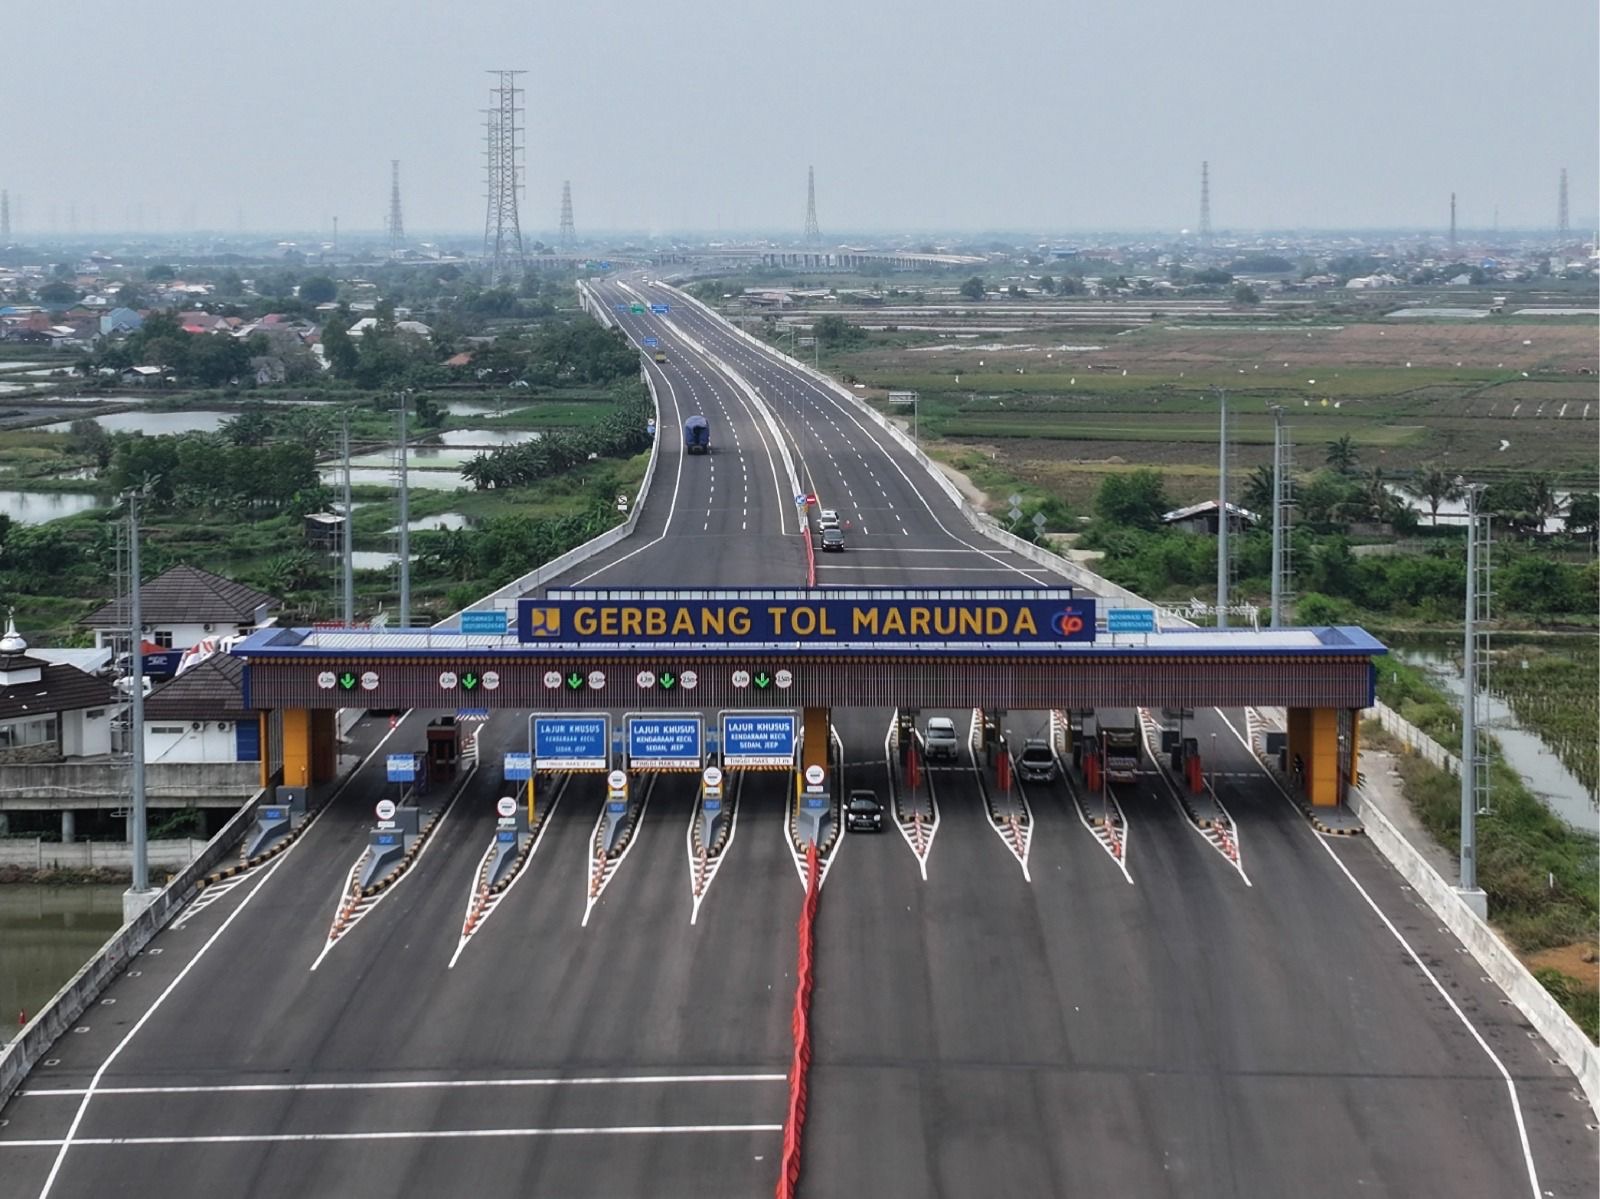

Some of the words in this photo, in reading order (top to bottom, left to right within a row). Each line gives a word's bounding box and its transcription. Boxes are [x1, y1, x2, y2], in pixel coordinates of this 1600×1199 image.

[573, 607, 751, 636] GERBANG
[767, 607, 836, 636] TOL
[852, 607, 1038, 635] MARUNDA
[541, 725, 565, 733] LAJUR
[569, 725, 600, 733] KHUSUS
[633, 725, 660, 734] LAJUR
[663, 725, 696, 734] KHUSUS
[728, 723, 753, 731] LAJUR
[756, 722, 790, 731] KHUSUS
[636, 735, 674, 743] KENDARAAN
[731, 732, 768, 740] KENDARAAN
[769, 732, 786, 740] KECIL
[764, 741, 779, 749] JEEP
